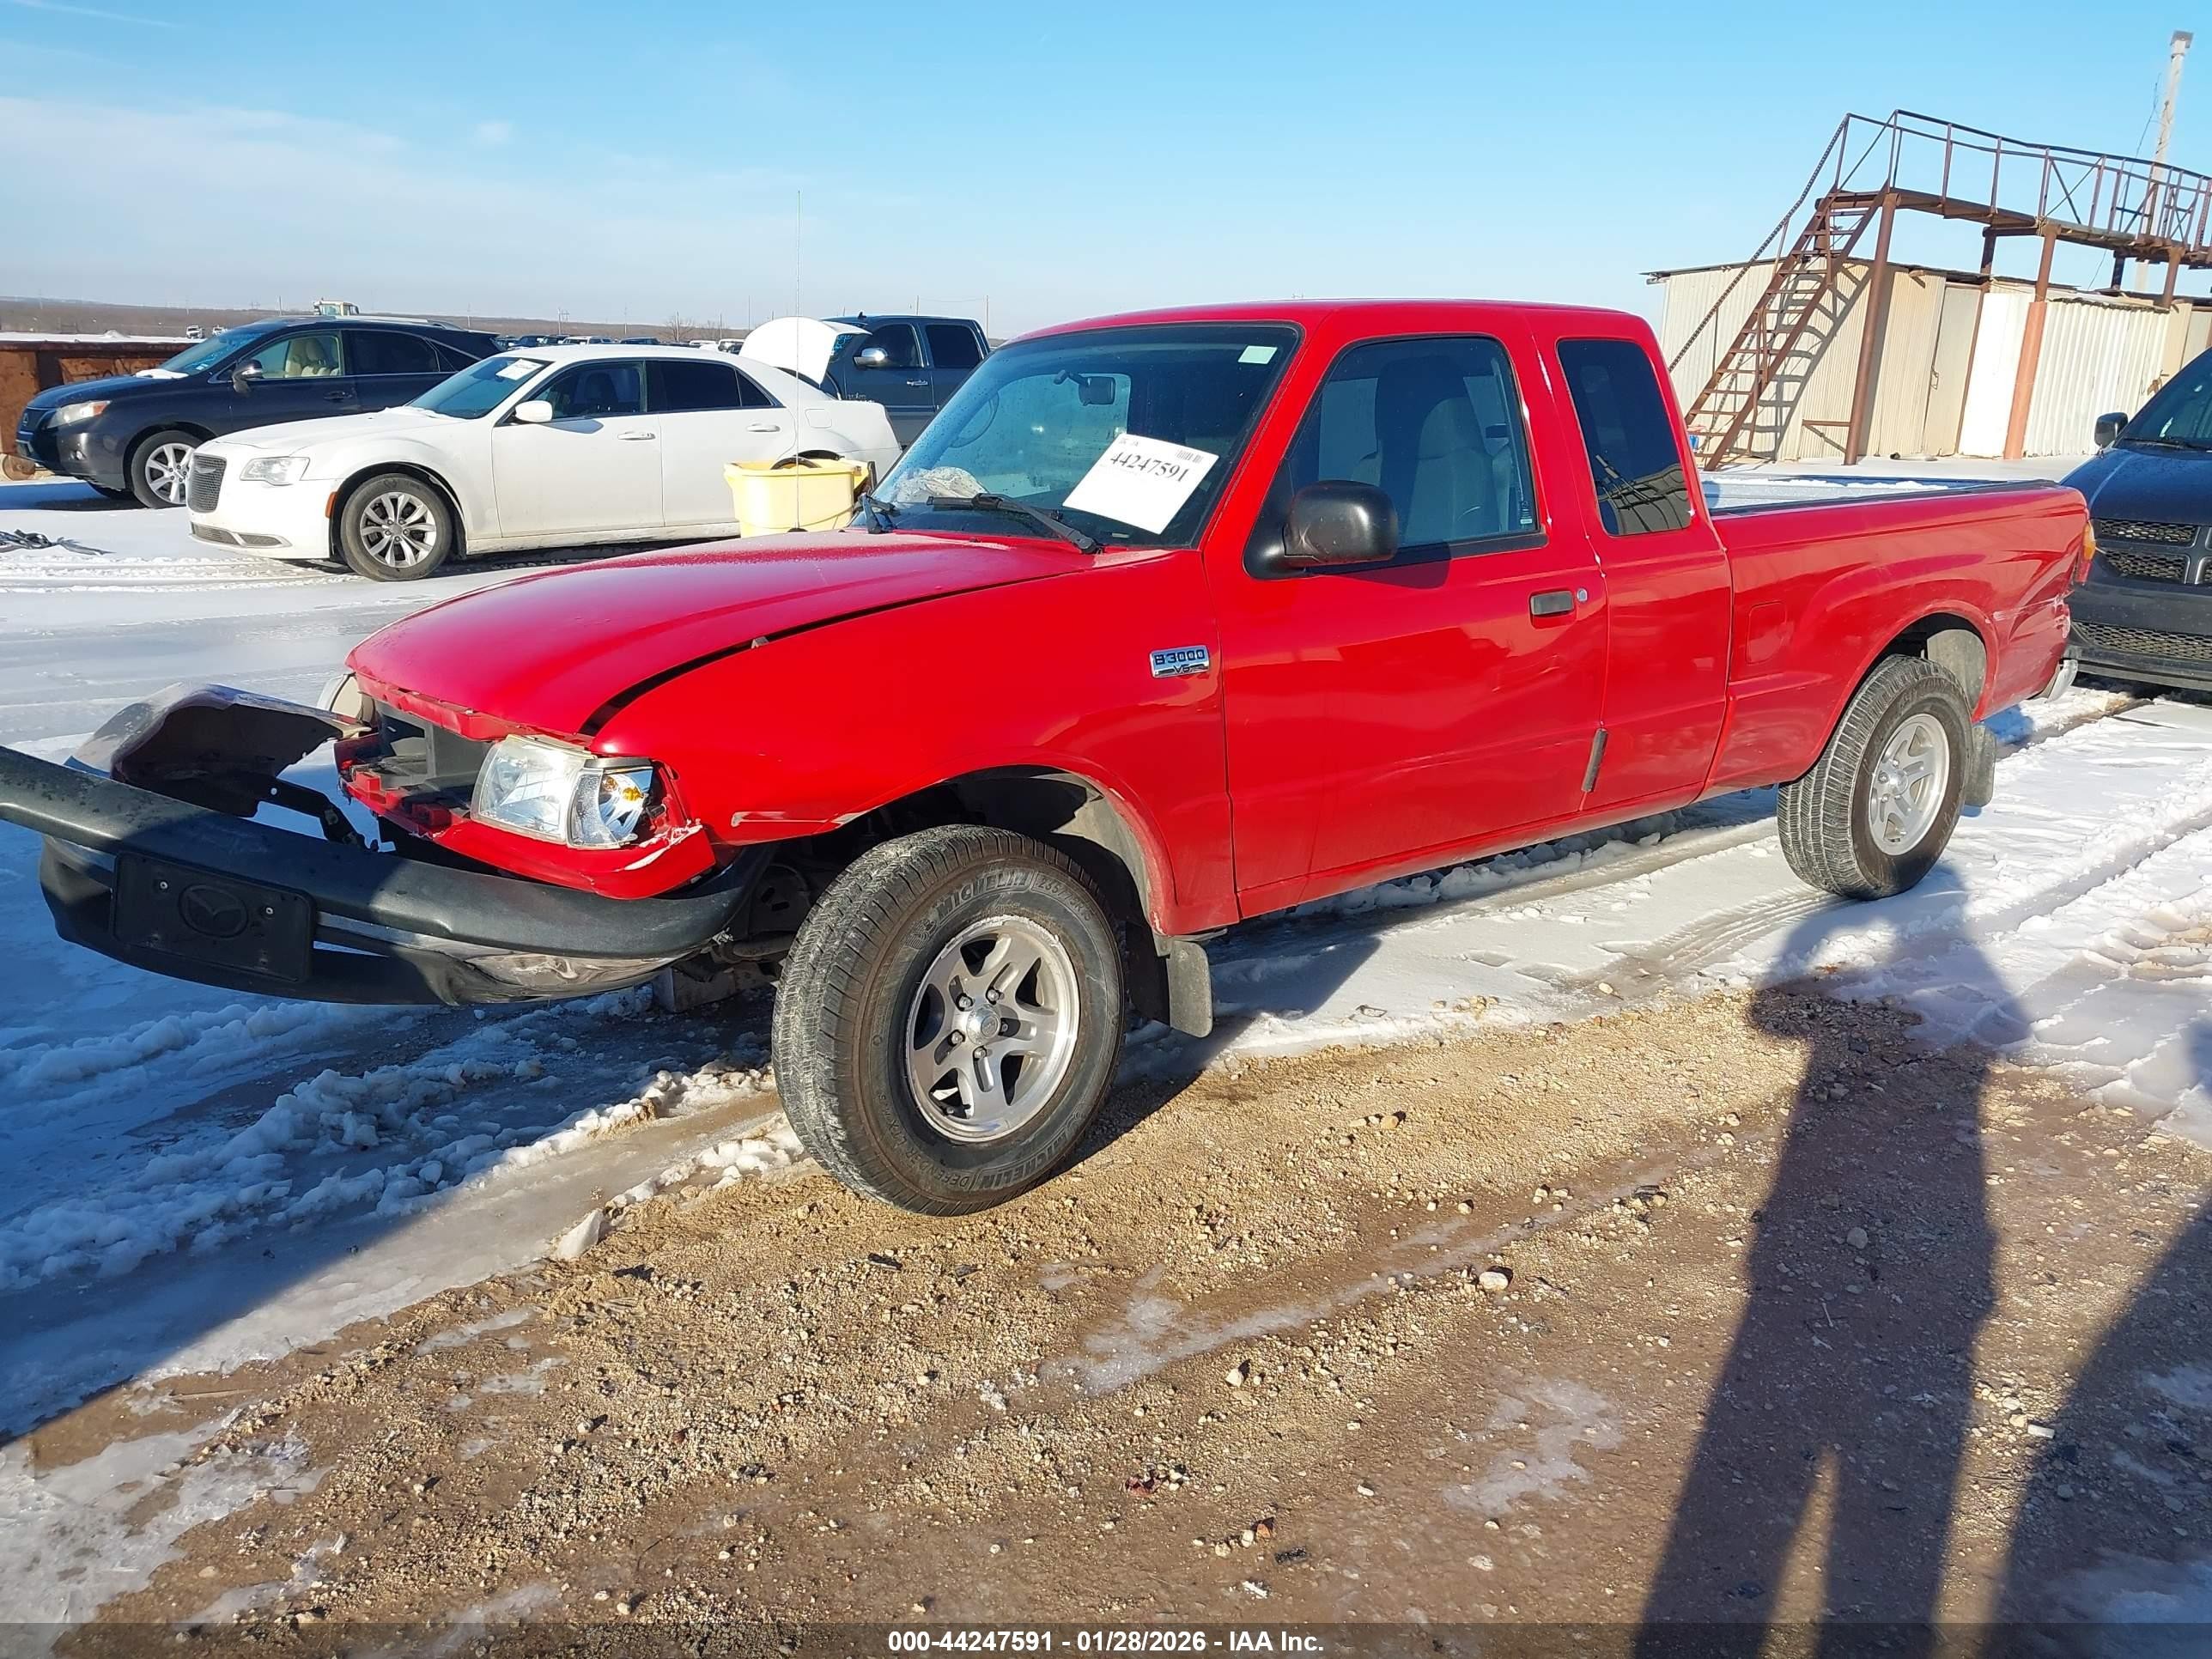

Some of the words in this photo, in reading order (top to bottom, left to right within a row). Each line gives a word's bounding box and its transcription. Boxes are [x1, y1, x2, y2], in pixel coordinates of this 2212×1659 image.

[1110, 452, 1190, 482] 44247591
[1154, 649, 1206, 665] B3000
[935, 871, 1029, 920] MICHELIN
[905, 1148, 969, 1188] DEFENDER
